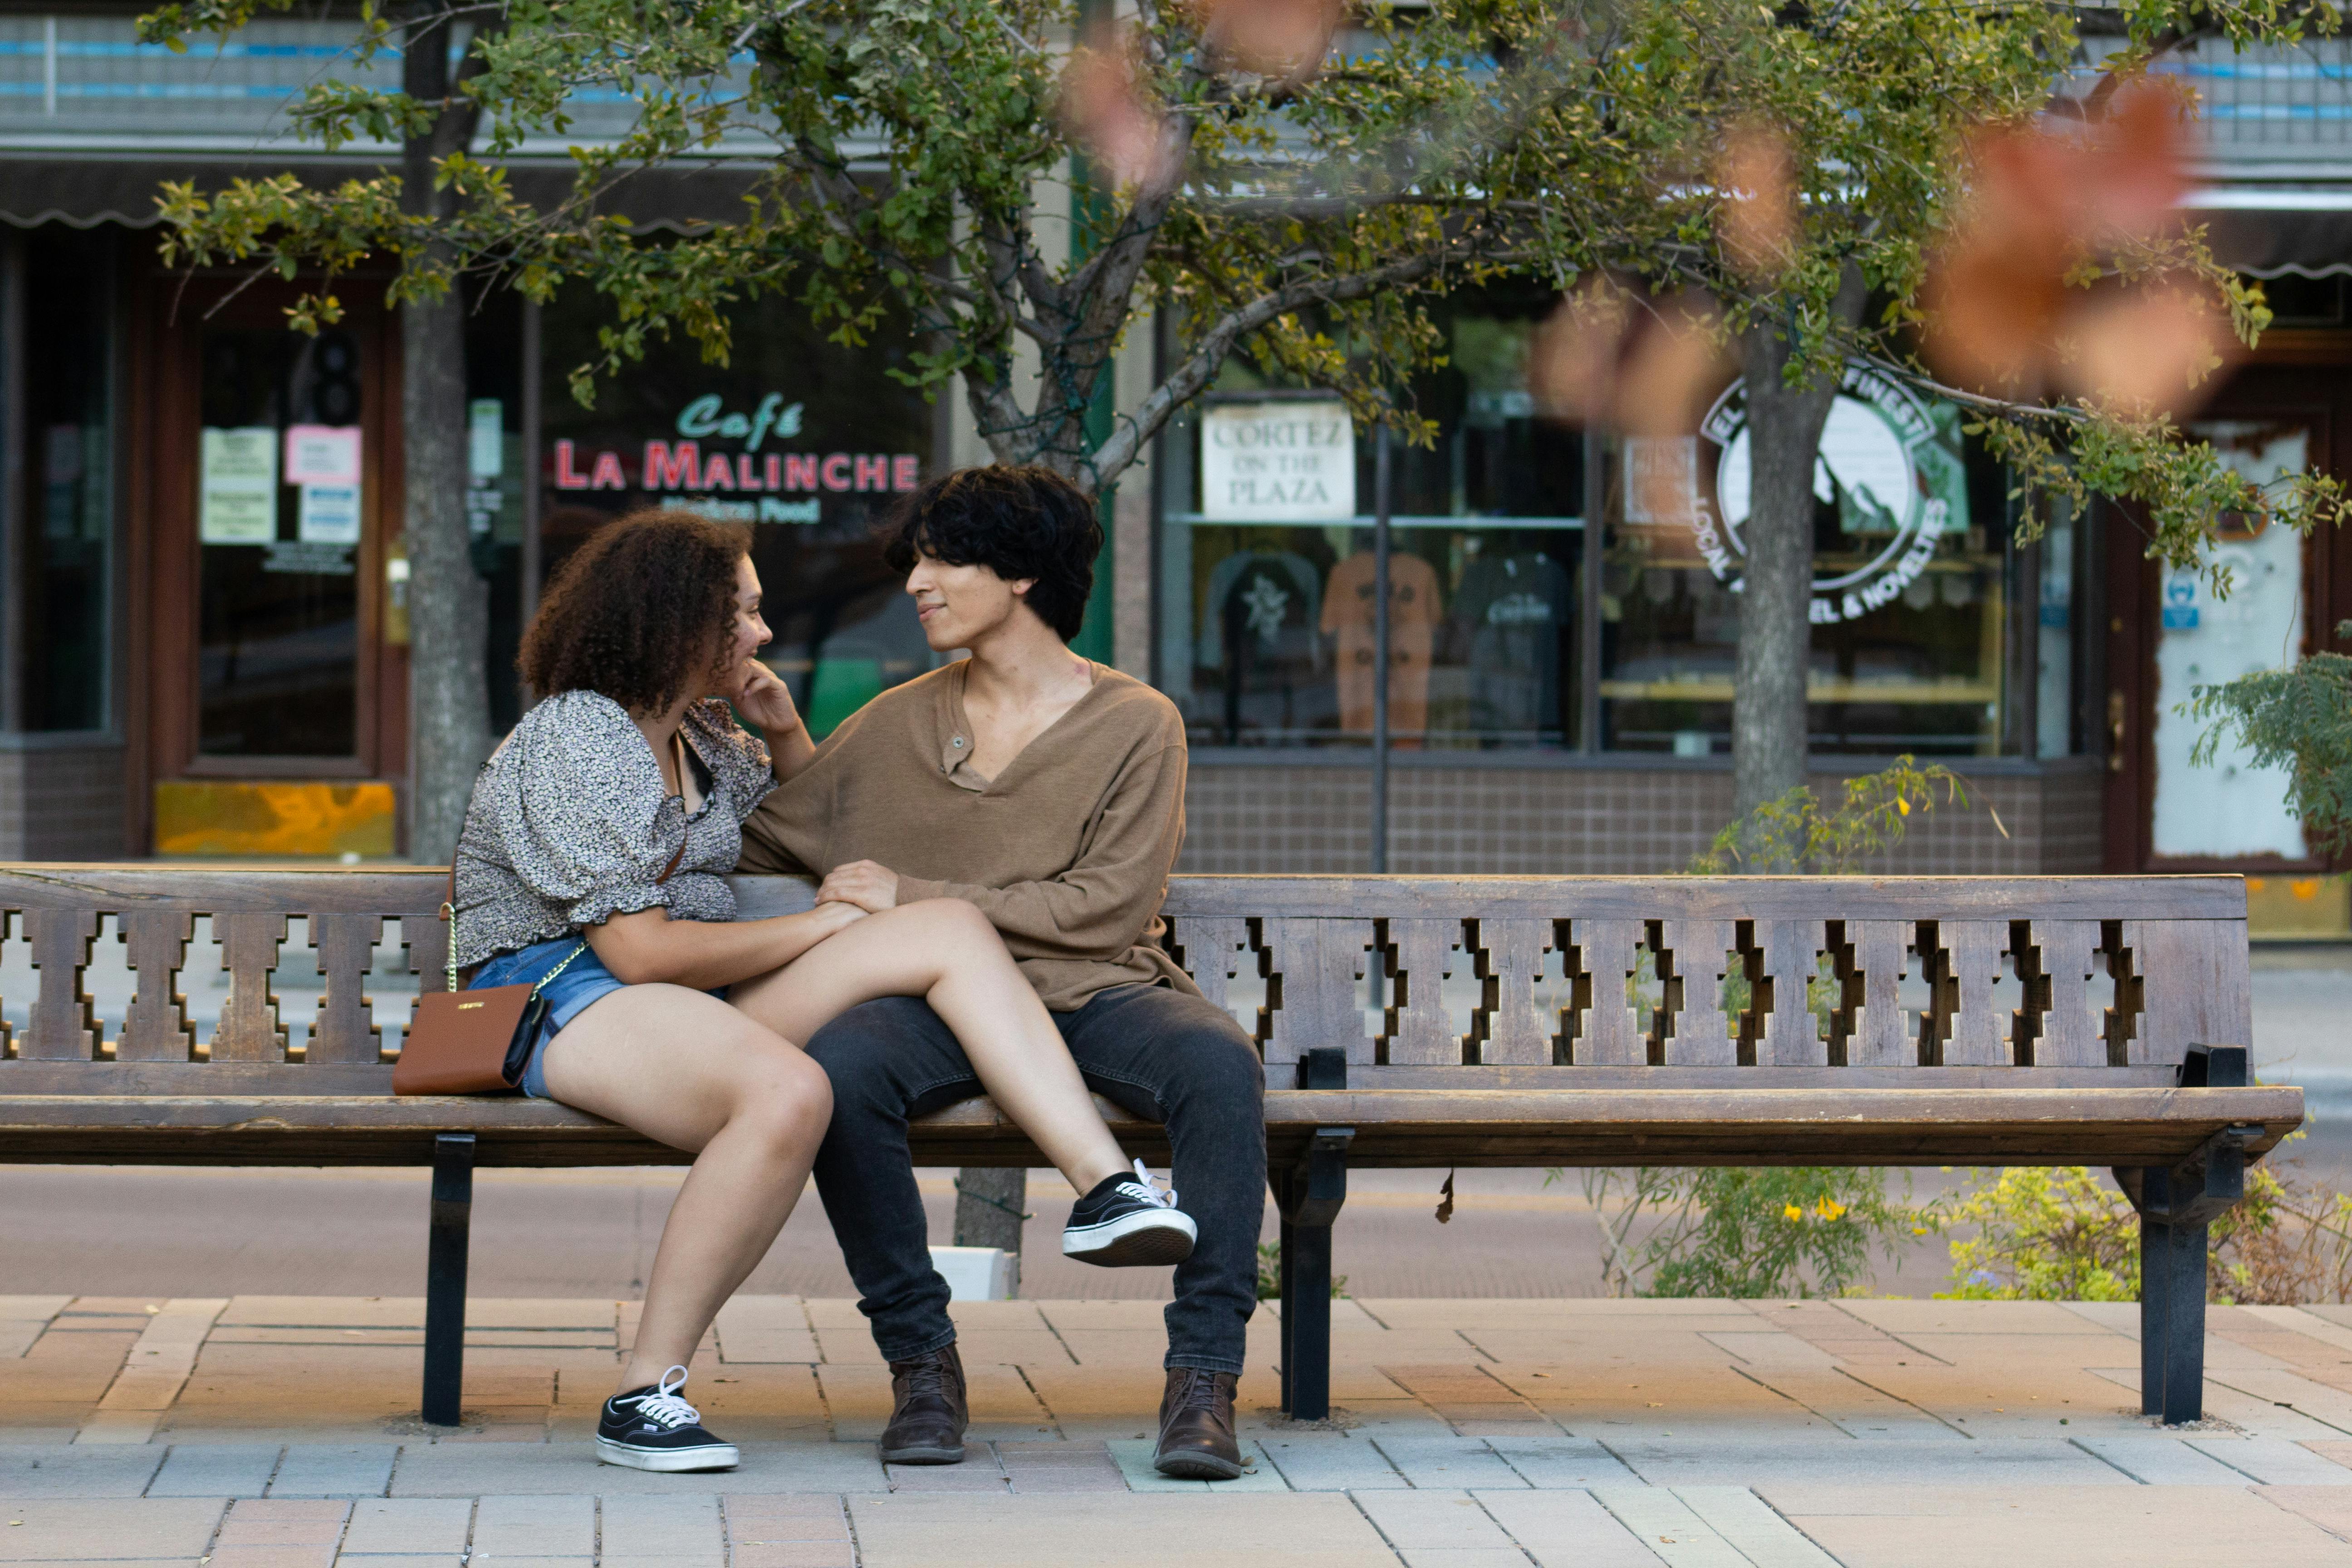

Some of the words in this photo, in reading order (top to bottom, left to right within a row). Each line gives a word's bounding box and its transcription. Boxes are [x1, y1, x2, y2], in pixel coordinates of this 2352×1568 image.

[1842, 368, 1926, 435] FINEST
[1213, 421, 1343, 448] CORTEZ
[642, 439, 920, 492] MALINCHE
[1232, 455, 1268, 473] ON
[1277, 455, 1321, 473] THE
[1229, 479, 1329, 504] PLAZA
[760, 496, 820, 523] Food
[1861, 499, 1946, 611] NOVELTIES
